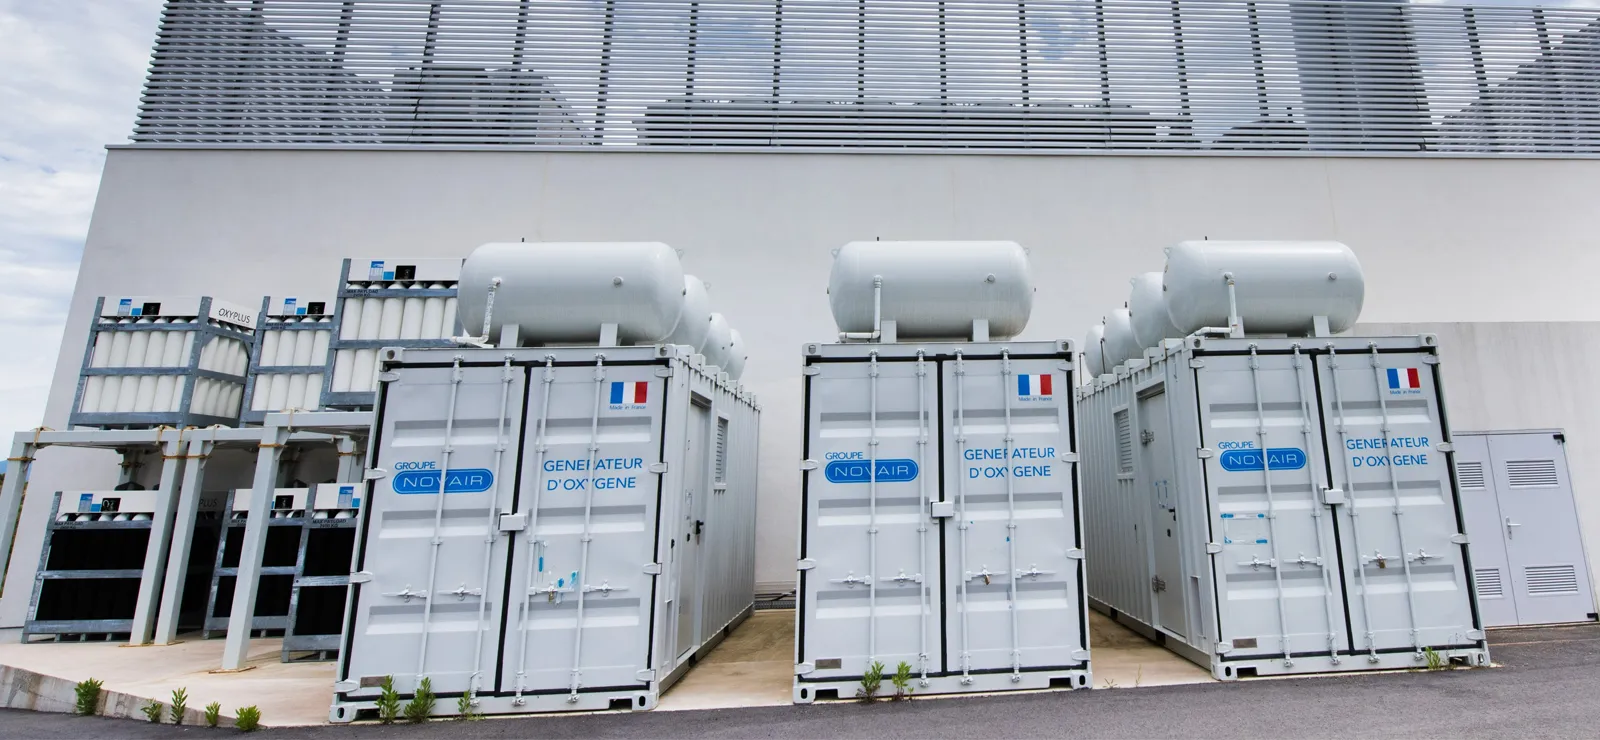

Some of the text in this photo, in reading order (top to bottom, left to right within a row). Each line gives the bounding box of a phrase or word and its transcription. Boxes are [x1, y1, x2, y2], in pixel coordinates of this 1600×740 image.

[218, 308, 251, 323] OXYPLUS
[1218, 441, 1254, 449] GROUPE
[825, 451, 863, 460] GROUPE
[394, 461, 437, 470] GROUPE
[200, 498, 218, 508] PLUS
